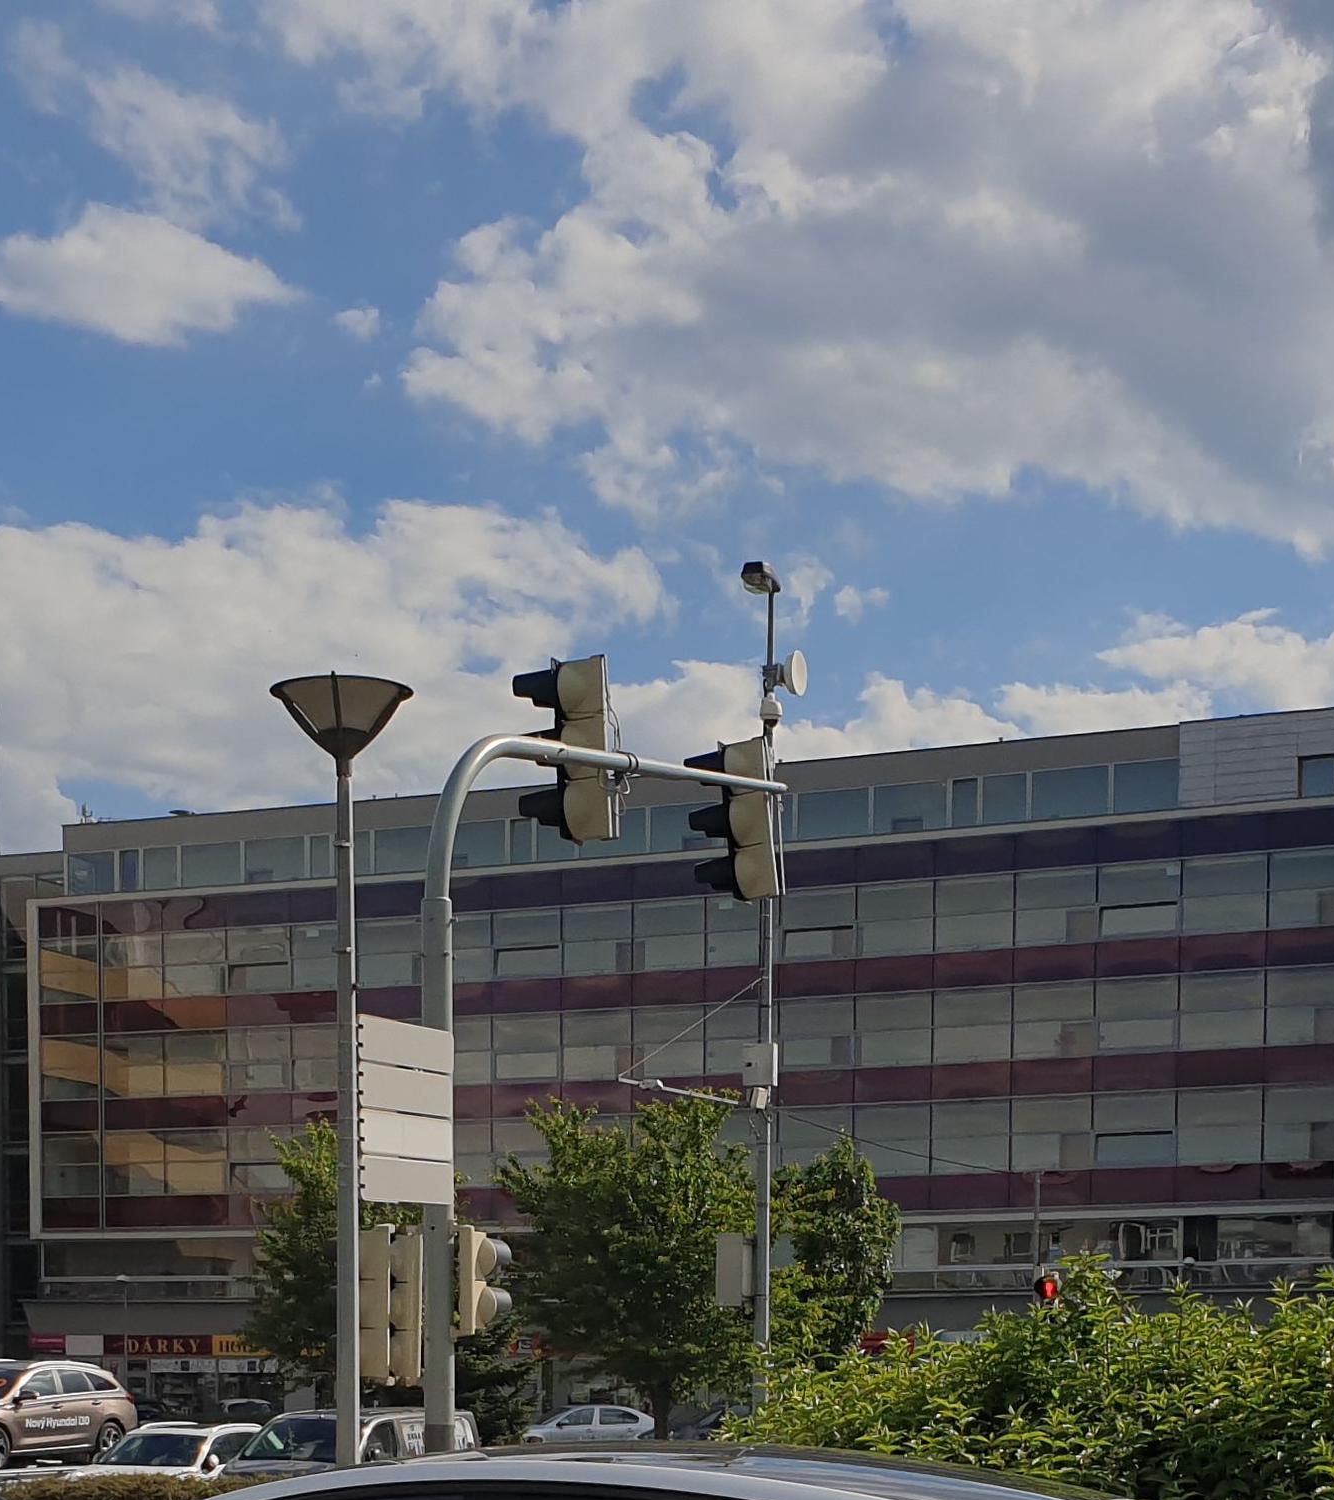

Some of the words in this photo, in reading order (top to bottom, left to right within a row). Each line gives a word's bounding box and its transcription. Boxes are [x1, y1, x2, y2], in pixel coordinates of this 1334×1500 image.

[128, 1337, 200, 1353] DÁRKY
[25, 1417, 46, 1430] Nový
[46, 1416, 78, 1429] Hyundai
